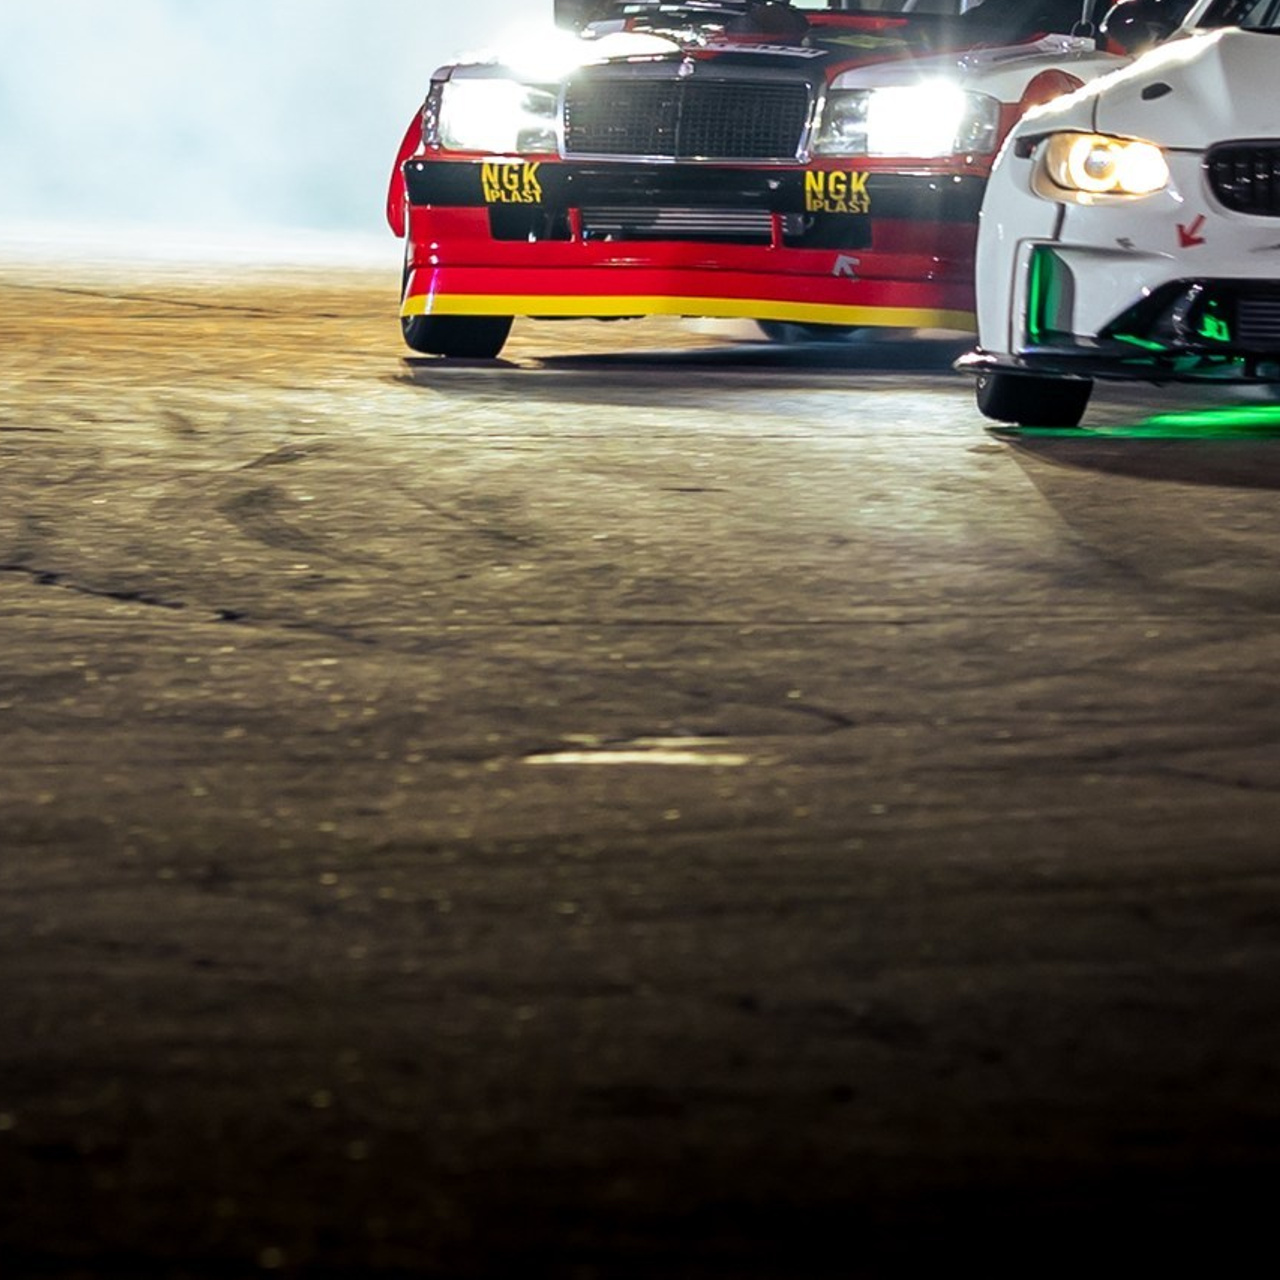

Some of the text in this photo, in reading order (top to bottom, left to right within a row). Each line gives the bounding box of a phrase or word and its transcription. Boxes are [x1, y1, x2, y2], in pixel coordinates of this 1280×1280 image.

[482, 161, 541, 194] NGK
[806, 170, 871, 203] NGK
[490, 190, 542, 203] PLAST
[812, 200, 870, 213] PLAST
